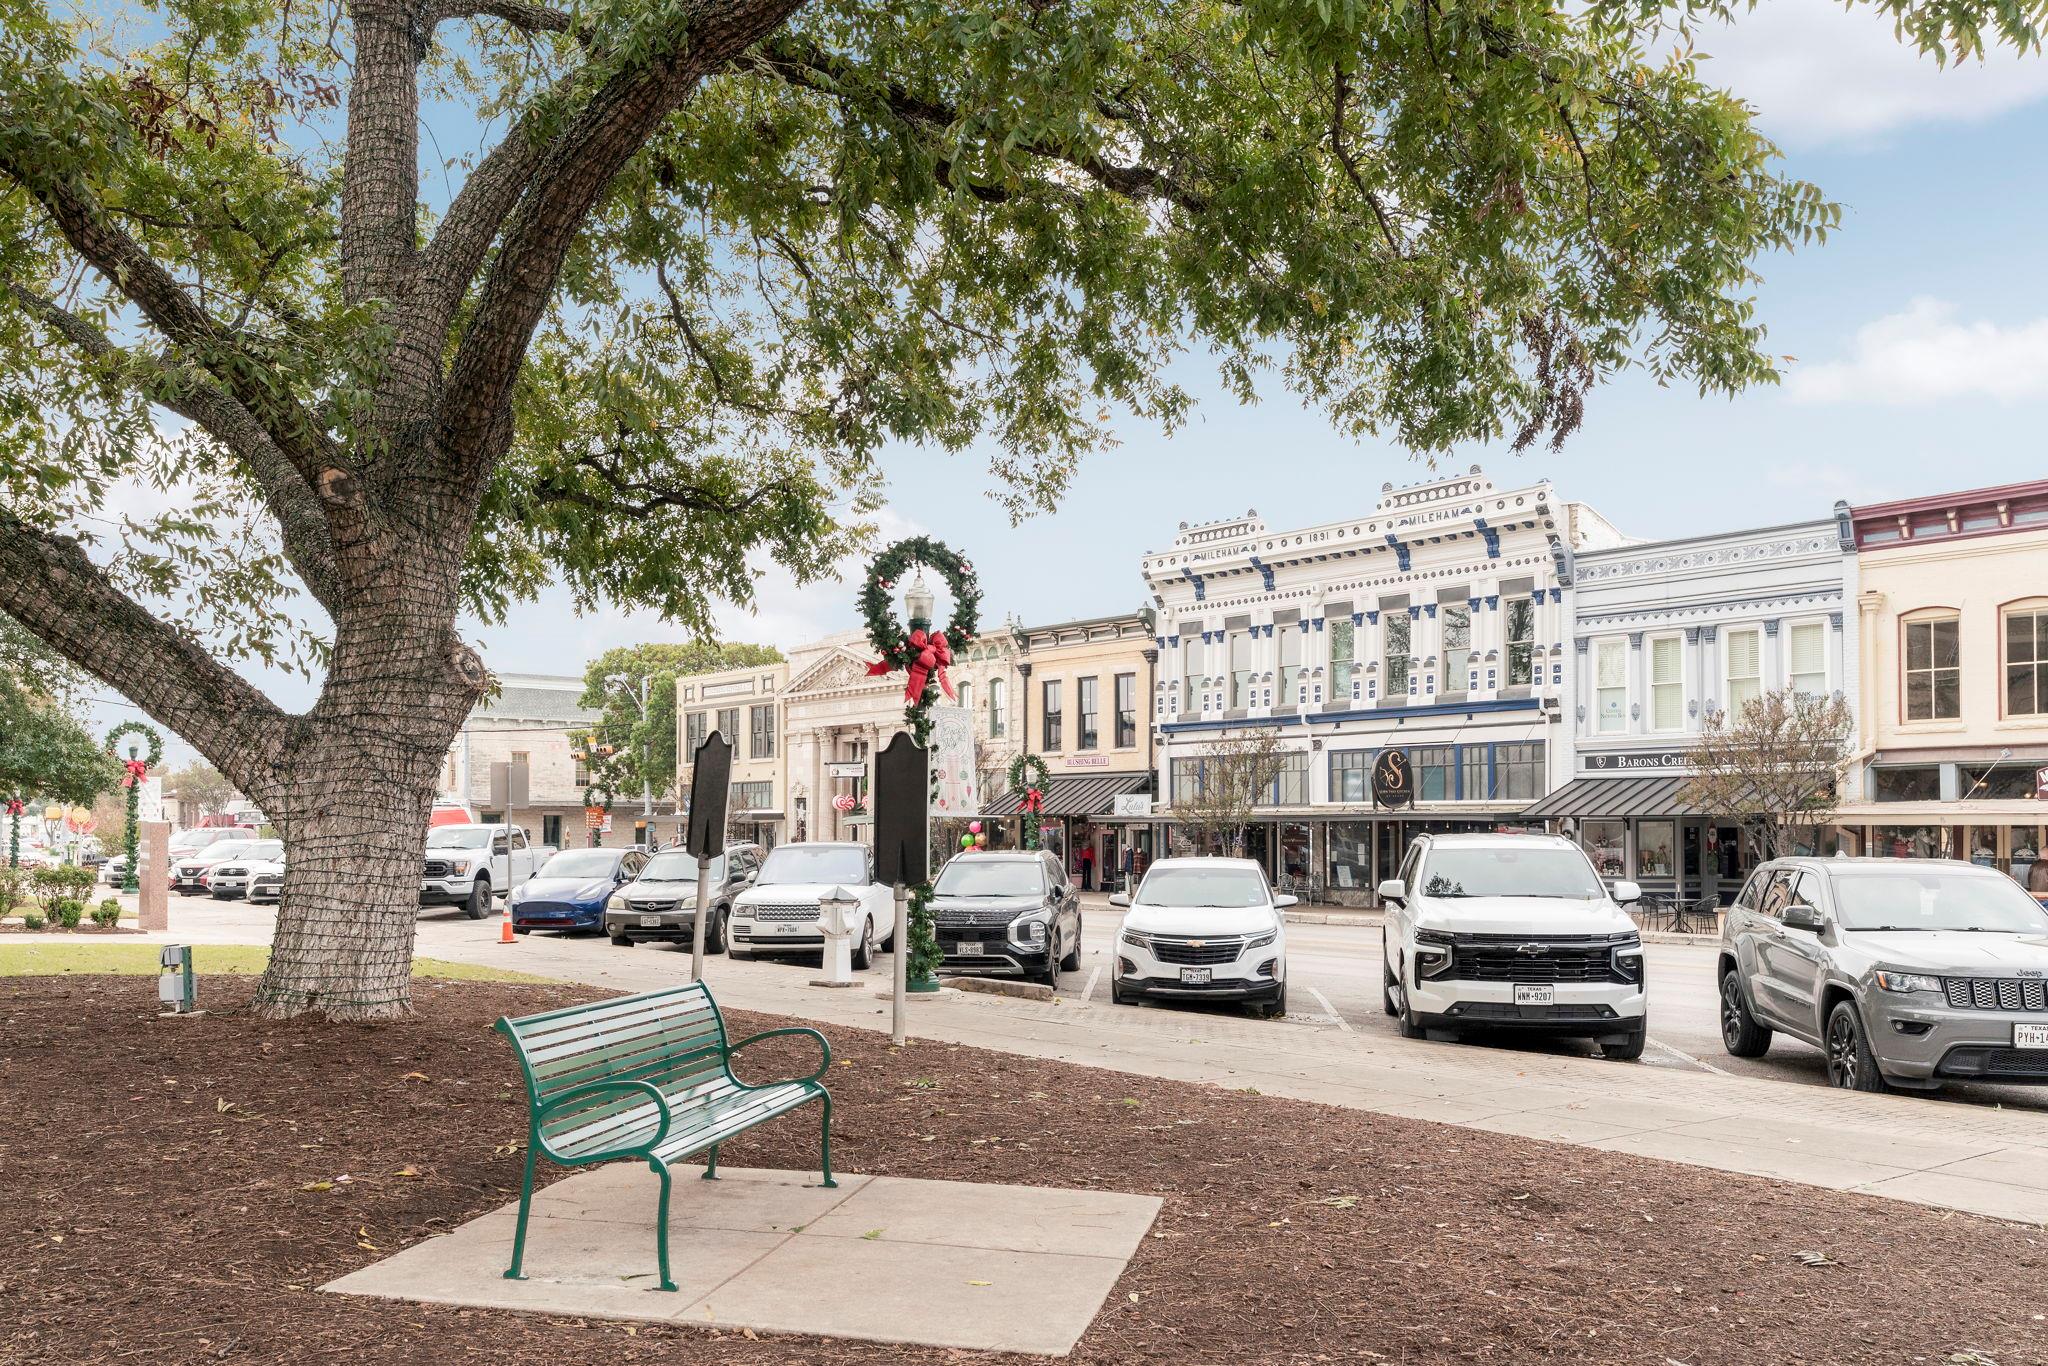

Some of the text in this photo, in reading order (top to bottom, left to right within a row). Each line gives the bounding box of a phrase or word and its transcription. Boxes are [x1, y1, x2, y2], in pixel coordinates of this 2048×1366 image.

[1408, 509, 1460, 526] MILEHAM
[1309, 532, 1330, 543] 1891
[1200, 546, 1240, 561] MILEHAM
[1092, 757, 1106, 765] BELLE
[1618, 755, 1659, 768] BARONS
[2016, 969, 2043, 979] Jeep
